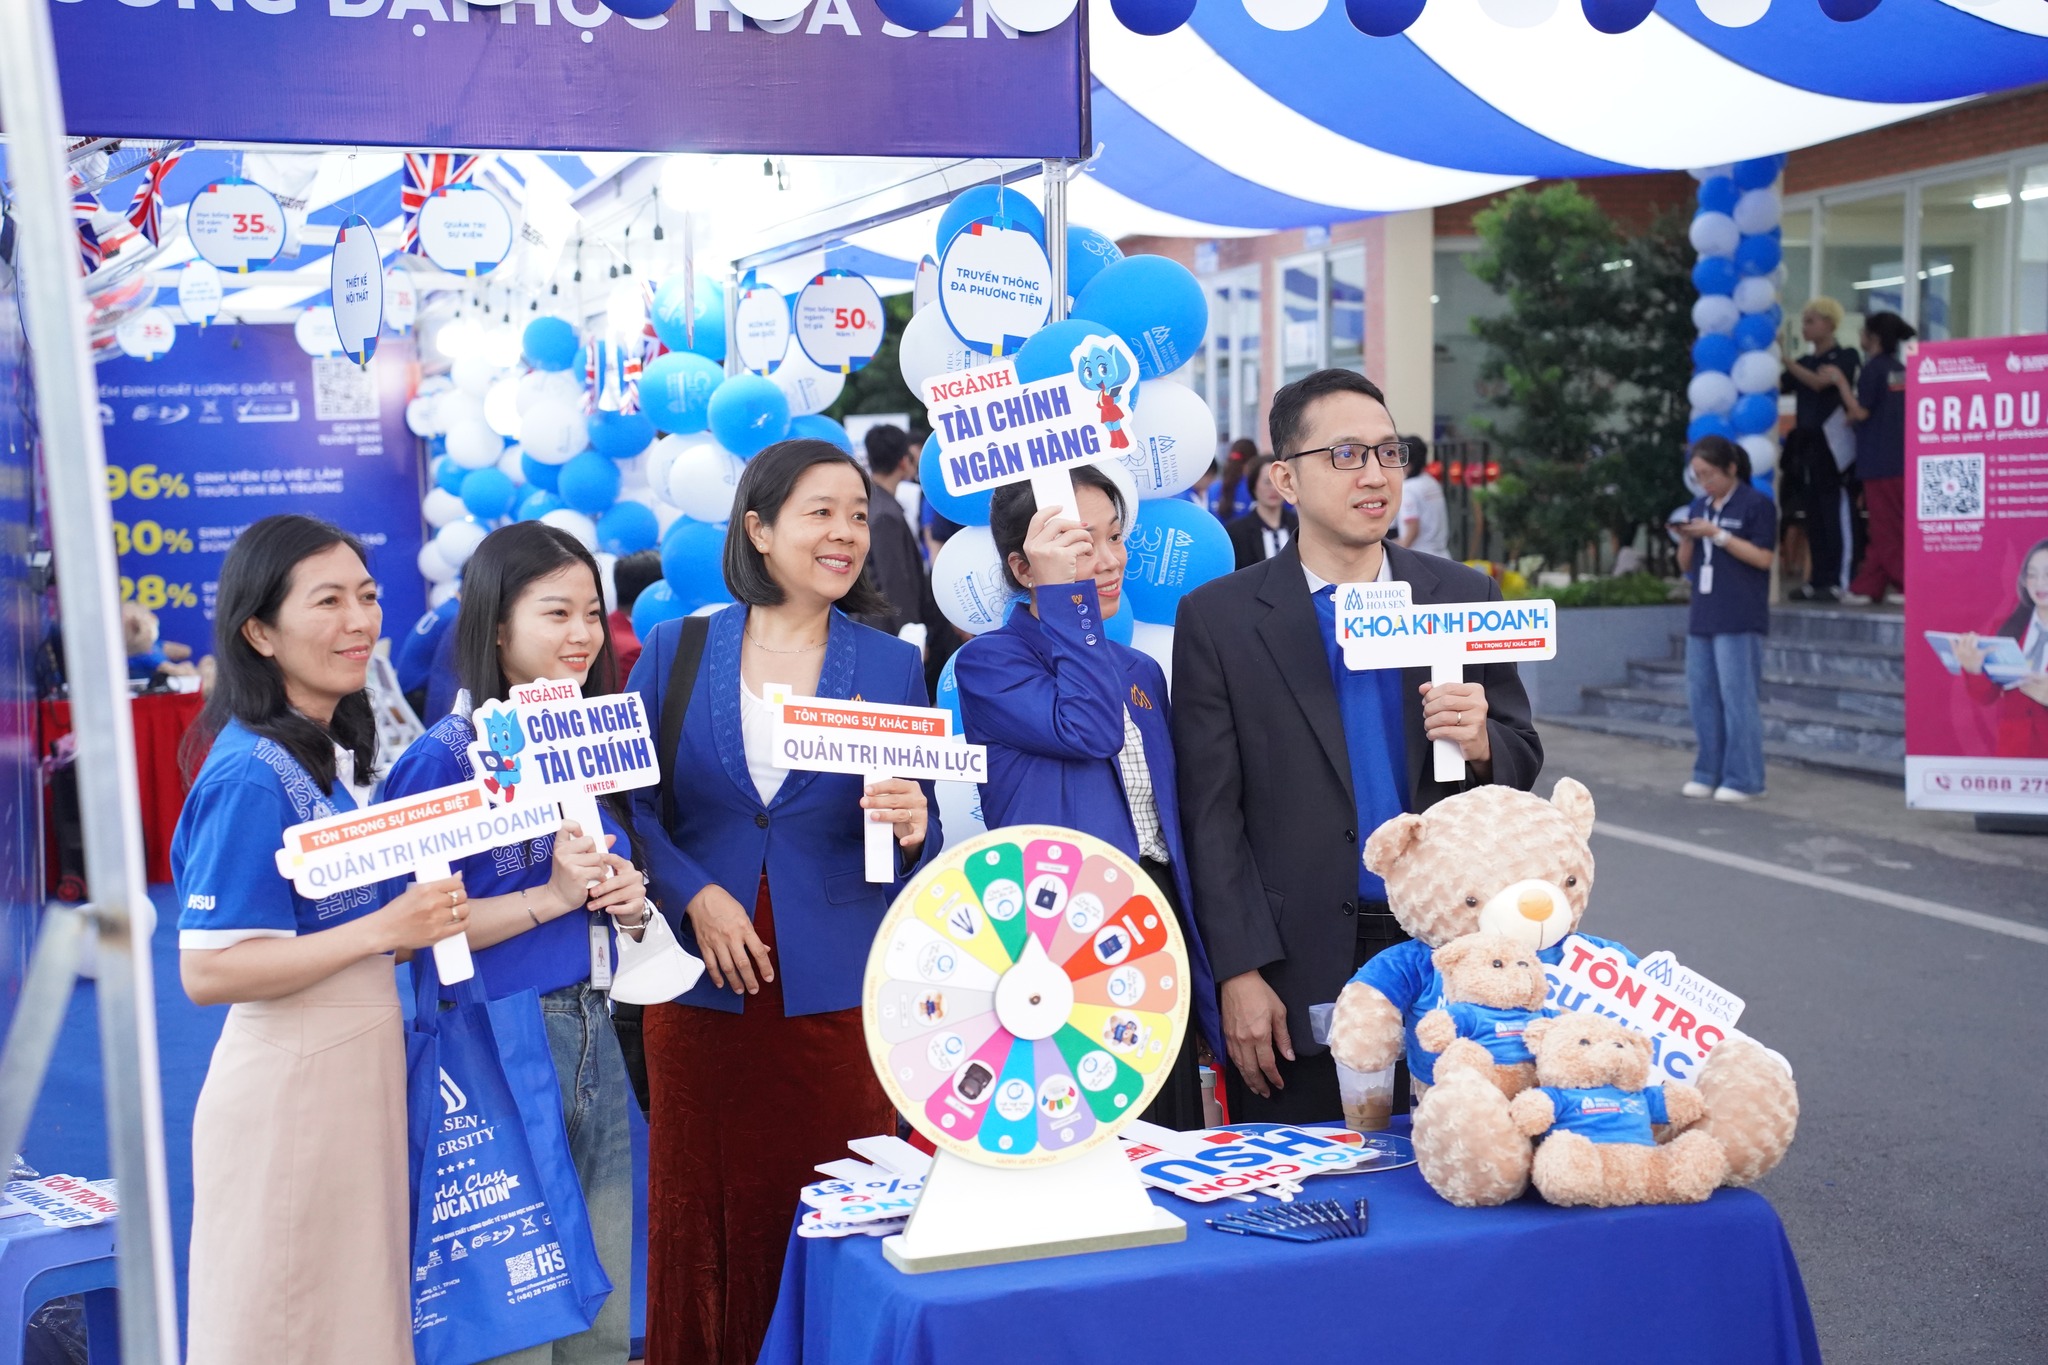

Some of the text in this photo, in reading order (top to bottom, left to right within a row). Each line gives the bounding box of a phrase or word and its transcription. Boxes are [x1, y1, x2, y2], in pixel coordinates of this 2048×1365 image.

[345, 272, 368, 289] THIẾT KẾ
[950, 281, 1043, 308] ĐA PHƯƠNG TIỆN
[956, 266, 1040, 291] TRUYỀN THÔNG
[345, 290, 369, 306] NỘI THẤT
[931, 369, 1012, 403] NGÀNH
[938, 385, 1072, 443] TÀI CHÍNH
[1918, 391, 2041, 433] GRADU
[950, 424, 1102, 488] NGÂN HÀNG
[105, 464, 190, 500] 96%
[1366, 600, 1406, 610] HOA SEN
[1344, 608, 1549, 639] KHOA KINH DOANH
[1471, 642, 1483, 650] TÔN
[1484, 642, 1503, 651] TRỌNG
[1512, 639, 1528, 648] KHÁC
[1528, 639, 1541, 648] BIỆT
[518, 684, 575, 705] NGÀNH
[527, 696, 642, 743] CÔNG NGHỆ
[794, 708, 935, 734] TÔN TRỌNG SỰ KHÁC BIỆT
[534, 736, 652, 785] TÀI CHÍNH
[784, 735, 981, 777] QUẢN TRỊ NHÂN LỰC
[583, 779, 618, 794] (FINTECH)
[311, 796, 470, 847] TÔN TRỌNG SỰ KHÁC BIỆT
[308, 804, 556, 888] QUẢN TRỊ KINH DOANH
[187, 894, 216, 911] HSU
[1569, 945, 1726, 1059] TÔN TRỌ
[1674, 984, 1734, 1023] HOA SEN
[443, 1114, 478, 1132] SEN
[437, 1126, 495, 1158] ERSITY
[1140, 1130, 1340, 1185] HSU
[435, 1168, 508, 1203] rld Class
[1186, 1147, 1373, 1195] TÔI CHỌN
[19, 1188, 65, 1210] KHÁC
[48, 1207, 94, 1222] BIỆT
[38, 1175, 119, 1213] TÔN TRỌNG
[432, 1181, 511, 1224] UCATION
[537, 1249, 566, 1276] HS
[557, 1278, 571, 1287] 727
